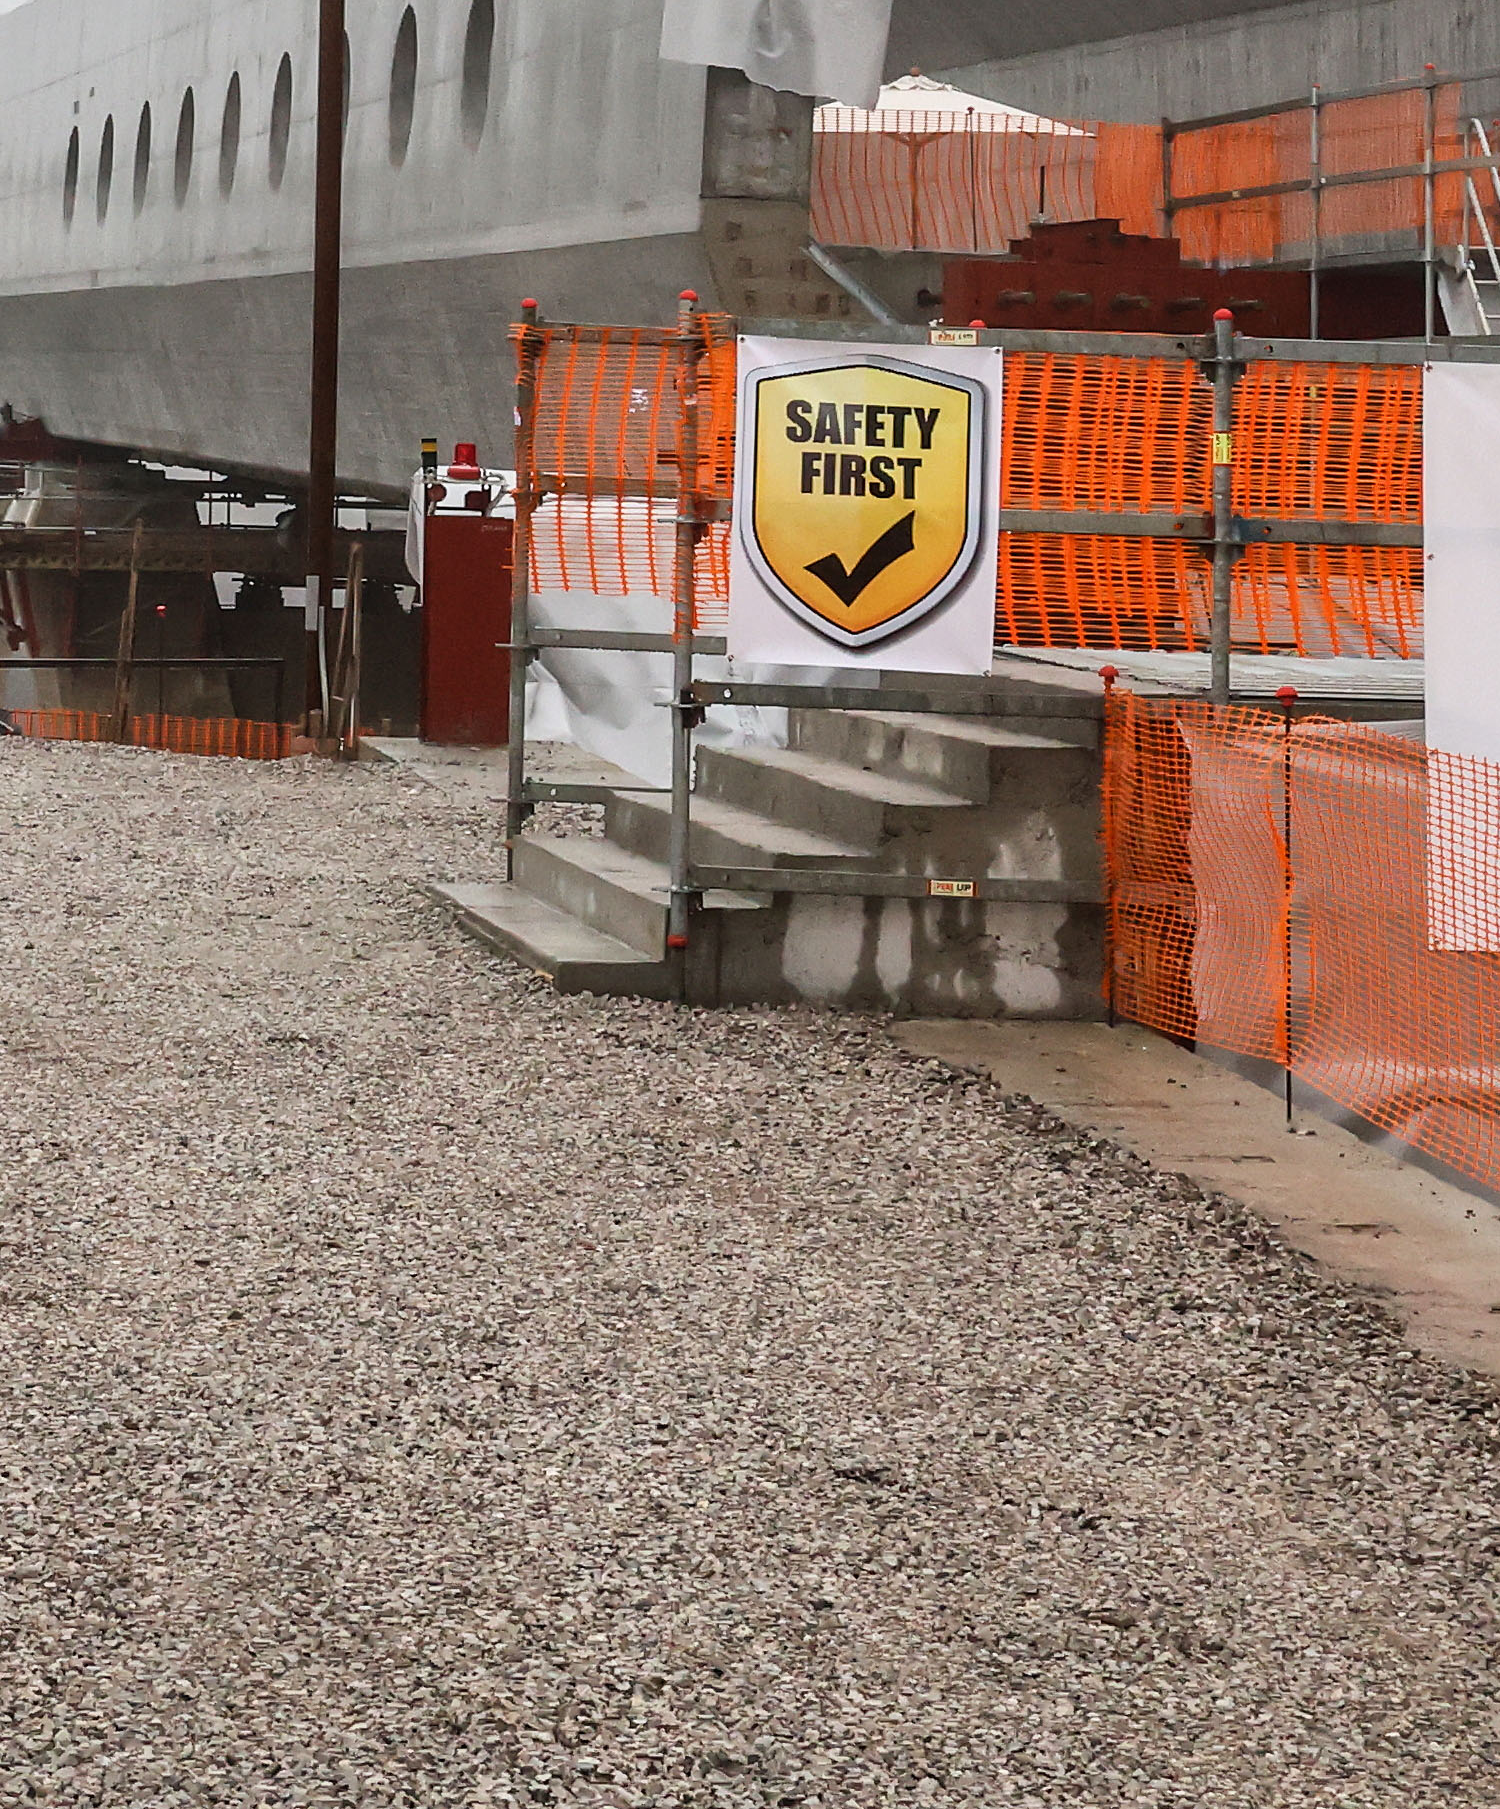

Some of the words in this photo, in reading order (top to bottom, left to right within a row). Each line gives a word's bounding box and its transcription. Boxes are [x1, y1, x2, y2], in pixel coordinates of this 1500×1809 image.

[786, 399, 941, 450] SAFETY
[801, 452, 923, 500] FIRST
[956, 883, 972, 892] UP
